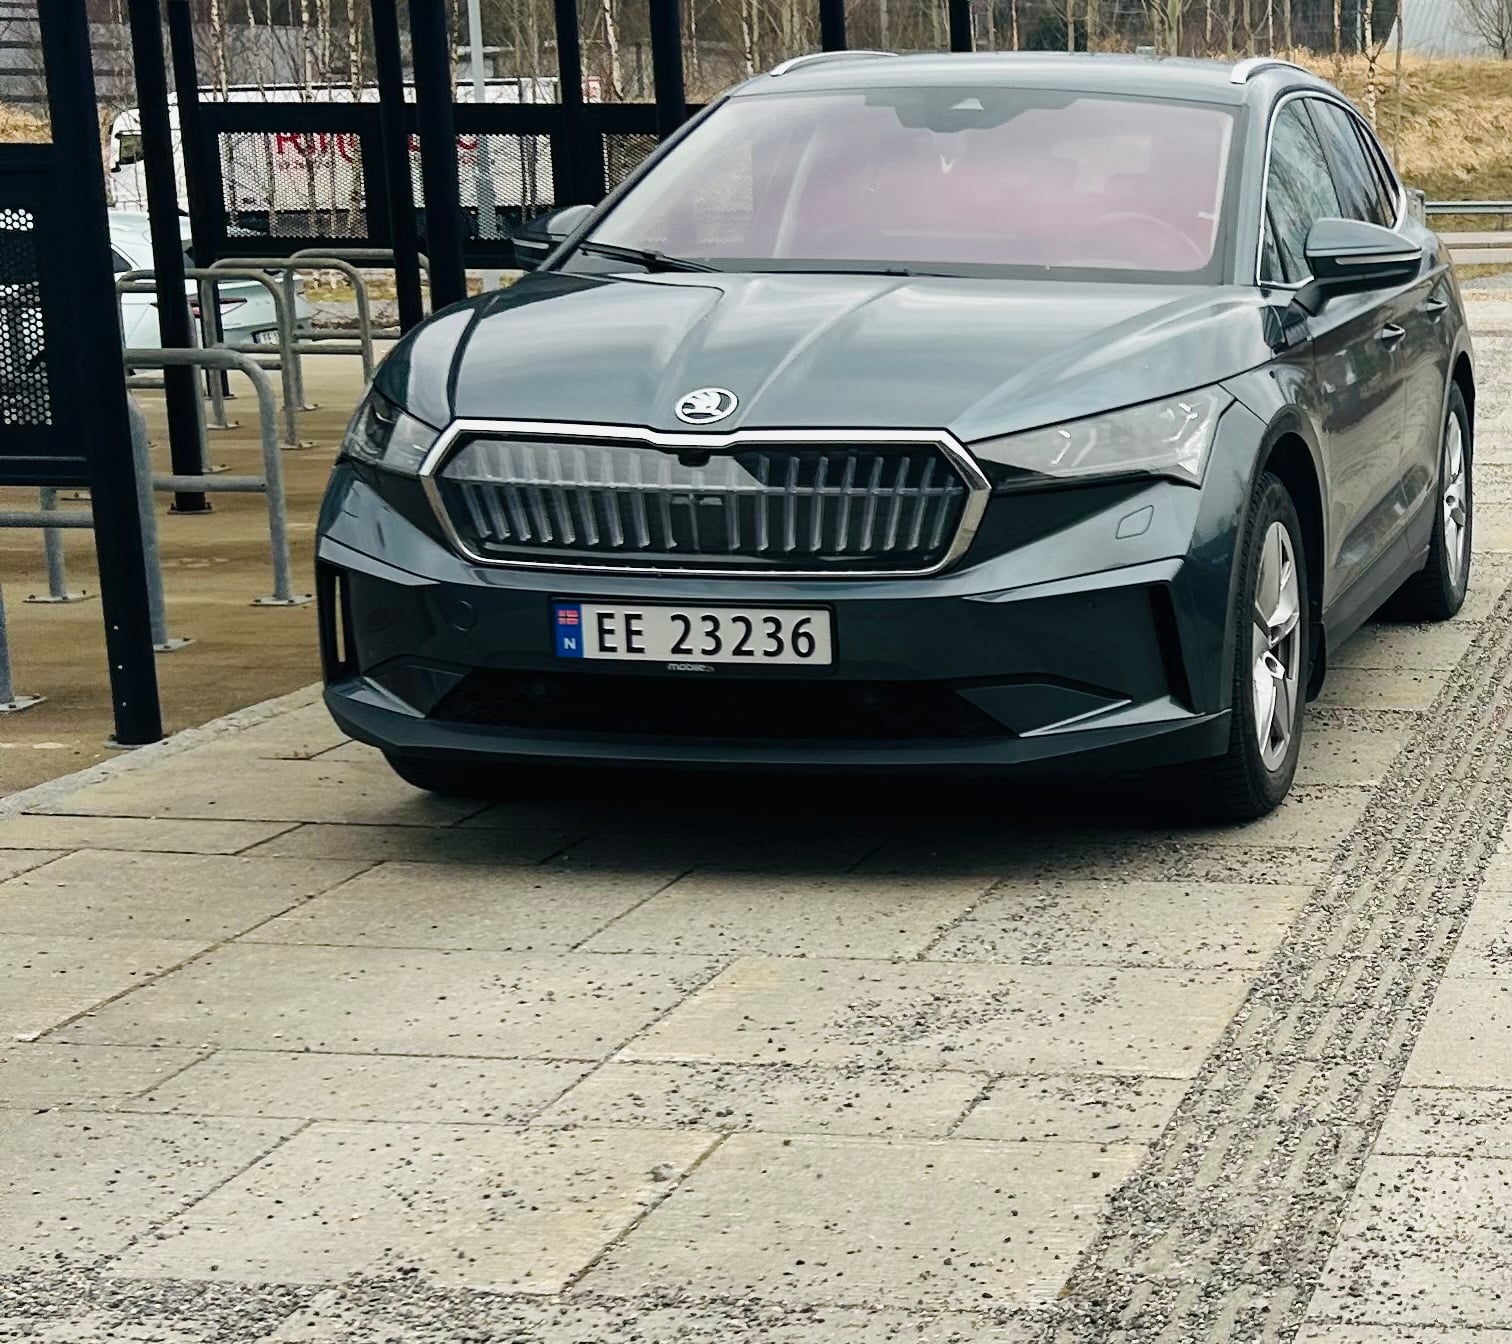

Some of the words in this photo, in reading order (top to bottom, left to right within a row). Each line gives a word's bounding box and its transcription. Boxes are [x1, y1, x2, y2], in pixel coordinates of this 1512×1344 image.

[563, 637, 577, 650] N
[596, 612, 645, 654] EE
[670, 613, 816, 658] 23236
